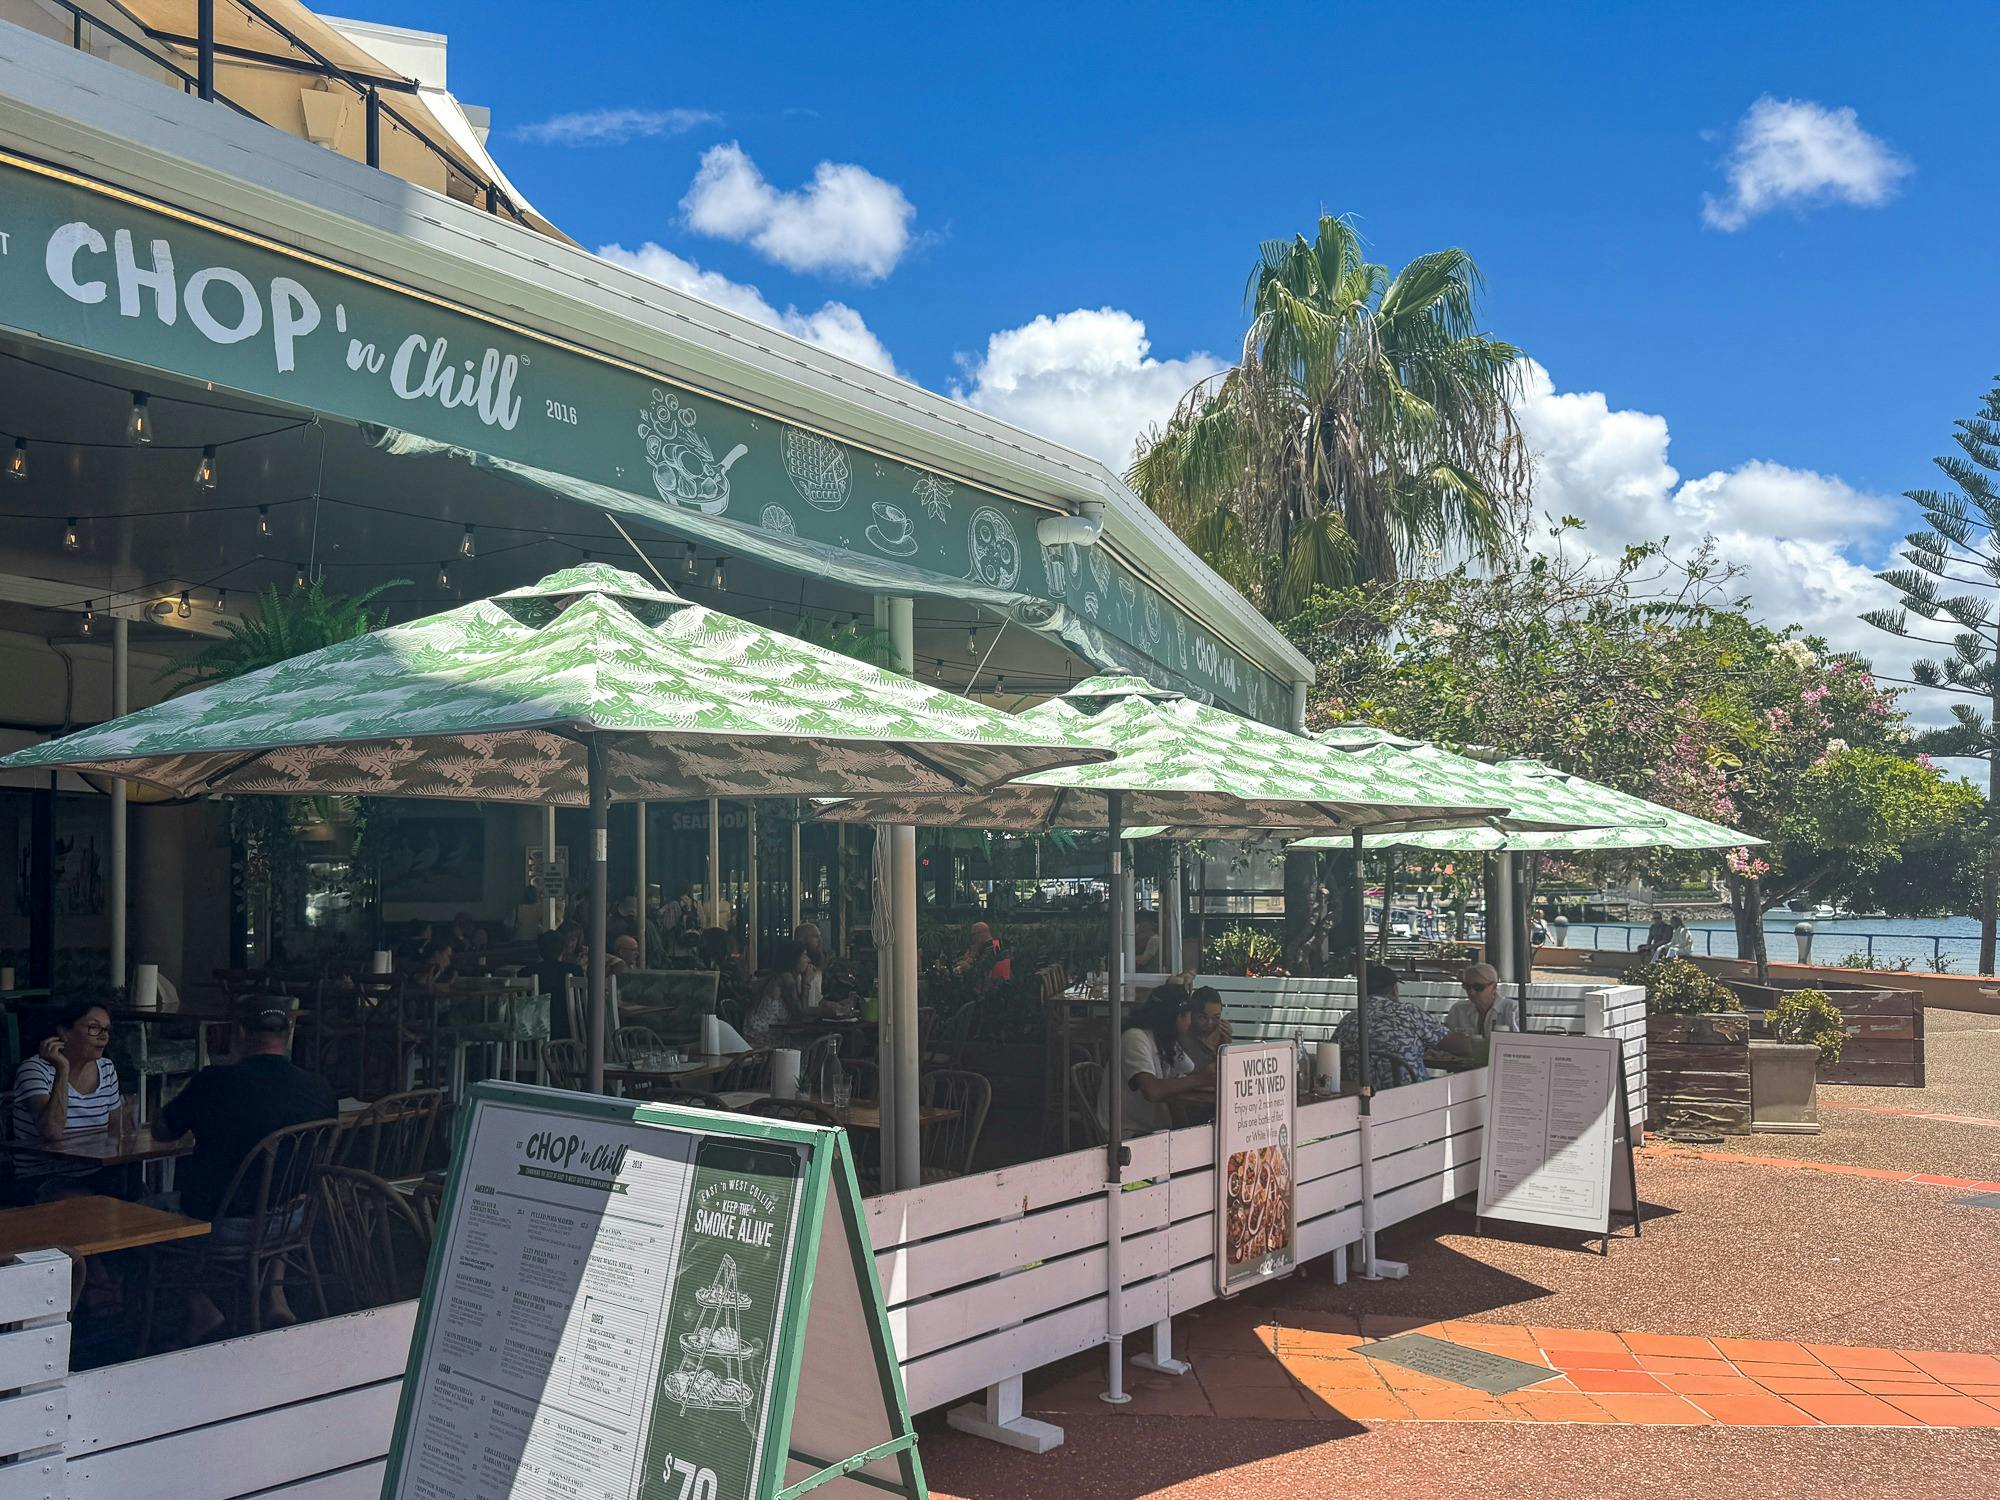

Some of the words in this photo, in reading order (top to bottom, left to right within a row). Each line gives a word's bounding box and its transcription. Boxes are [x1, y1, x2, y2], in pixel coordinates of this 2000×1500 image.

[45, 221, 321, 373] CHOP
[390, 334, 522, 431] Chill
[546, 400, 578, 425] 2016
[672, 811, 747, 830] SEAFOD
[1243, 1057, 1278, 1077] WICKED
[1234, 1079, 1253, 1098] TUE
[1266, 1075, 1286, 1094] WED
[526, 1131, 579, 1169] CHOP
[589, 1143, 629, 1176] Chill
[700, 1184, 718, 1202] EAST
[729, 1179, 748, 1192] WEST
[749, 1184, 776, 1215] COLLIDE
[722, 1199, 738, 1214] KEEP
[739, 1202, 751, 1217] THE
[694, 1209, 737, 1240] SMOKE
[737, 1217, 775, 1248] ALIVE
